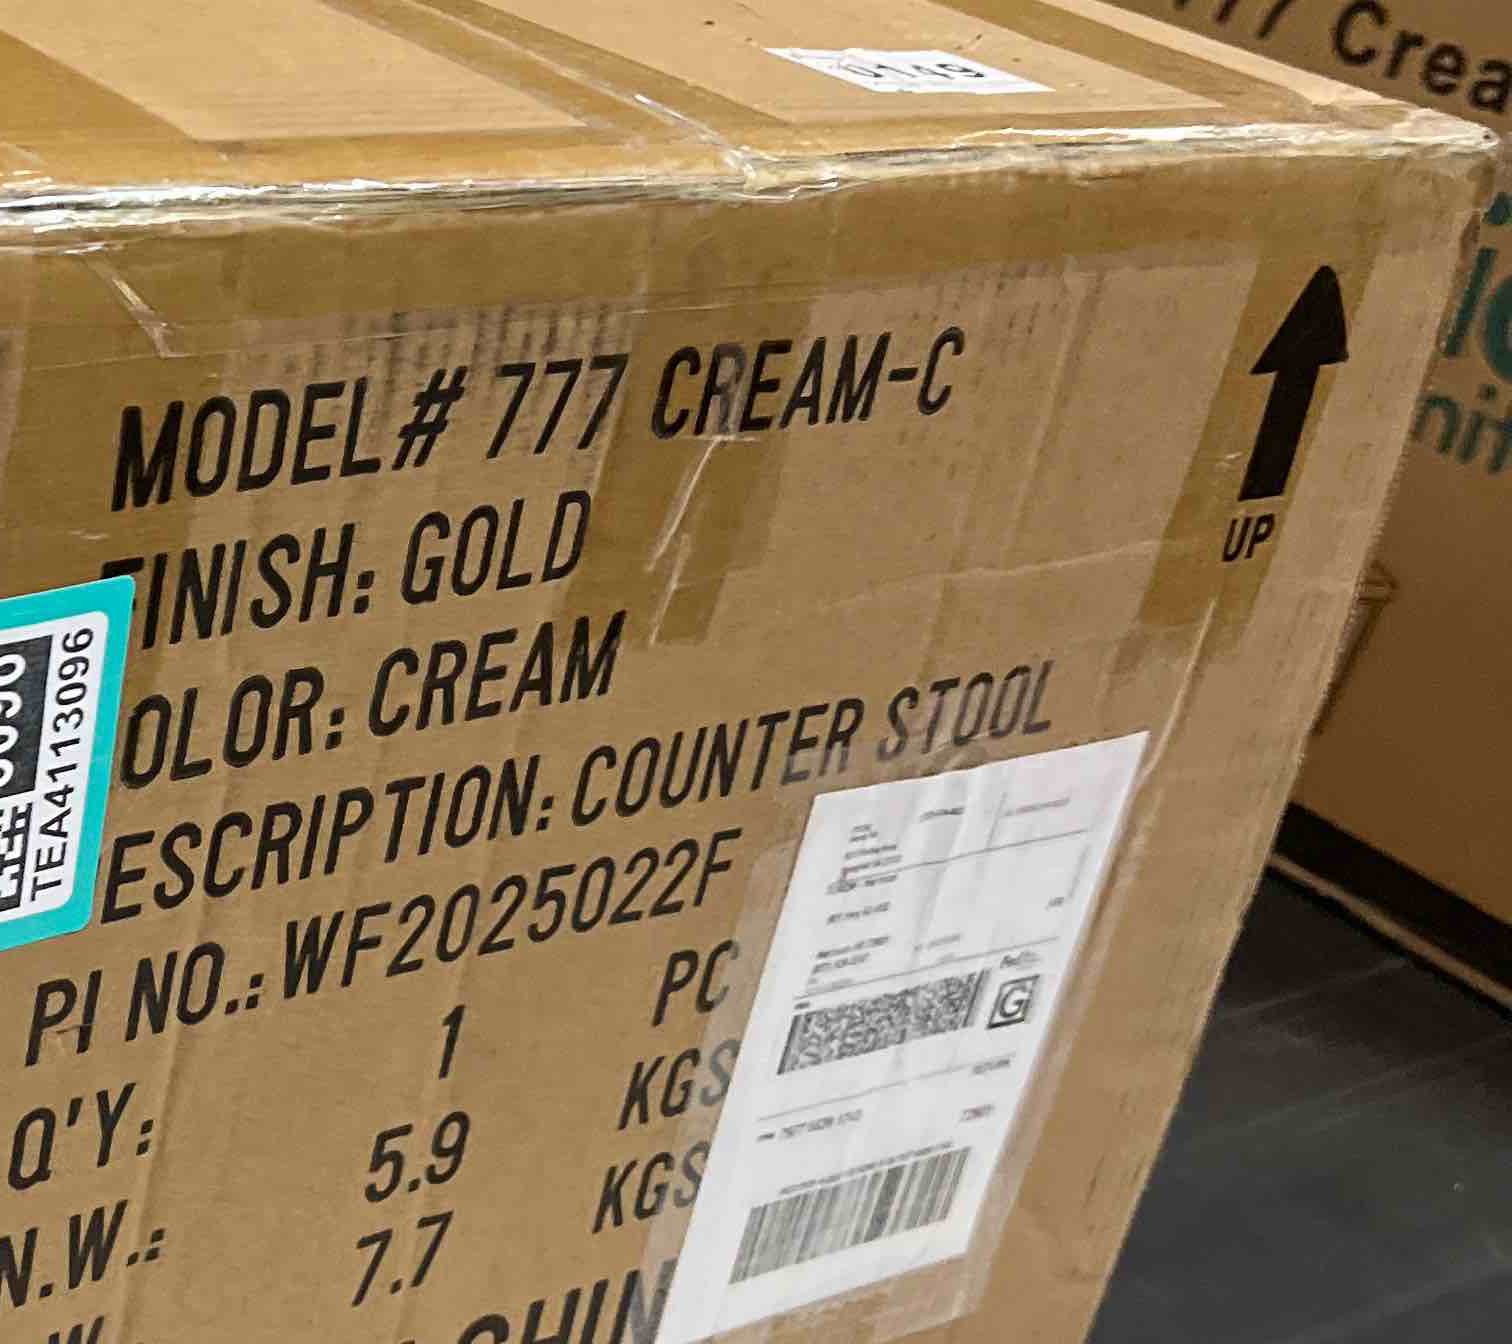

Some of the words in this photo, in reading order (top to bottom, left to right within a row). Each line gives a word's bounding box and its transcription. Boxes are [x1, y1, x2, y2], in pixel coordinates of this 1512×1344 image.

[487, 353, 629, 460] 777
[649, 325, 965, 440] CREAM-C
[99, 523, 375, 652] INISH:
[399, 489, 590, 606] GOLD
[1221, 512, 1276, 563] UP
[31, 626, 94, 902] TEA4113096
[119, 666, 344, 791] OLOR:
[367, 609, 628, 739] CREAM
[99, 753, 554, 925] ESCRIPTION:
[569, 697, 865, 826] COUNTER
[876, 659, 1055, 764] STOOL
[6, 1081, 156, 1192] Q'Y:
[437, 1003, 466, 1080] 1
[651, 939, 741, 1028] PC
[23, 970, 103, 1068] PI
[364, 1109, 472, 1205] 5.9
[616, 1037, 741, 1132] KGS
[351, 1209, 455, 1308] 7.7
[591, 1141, 714, 1234] KGS
